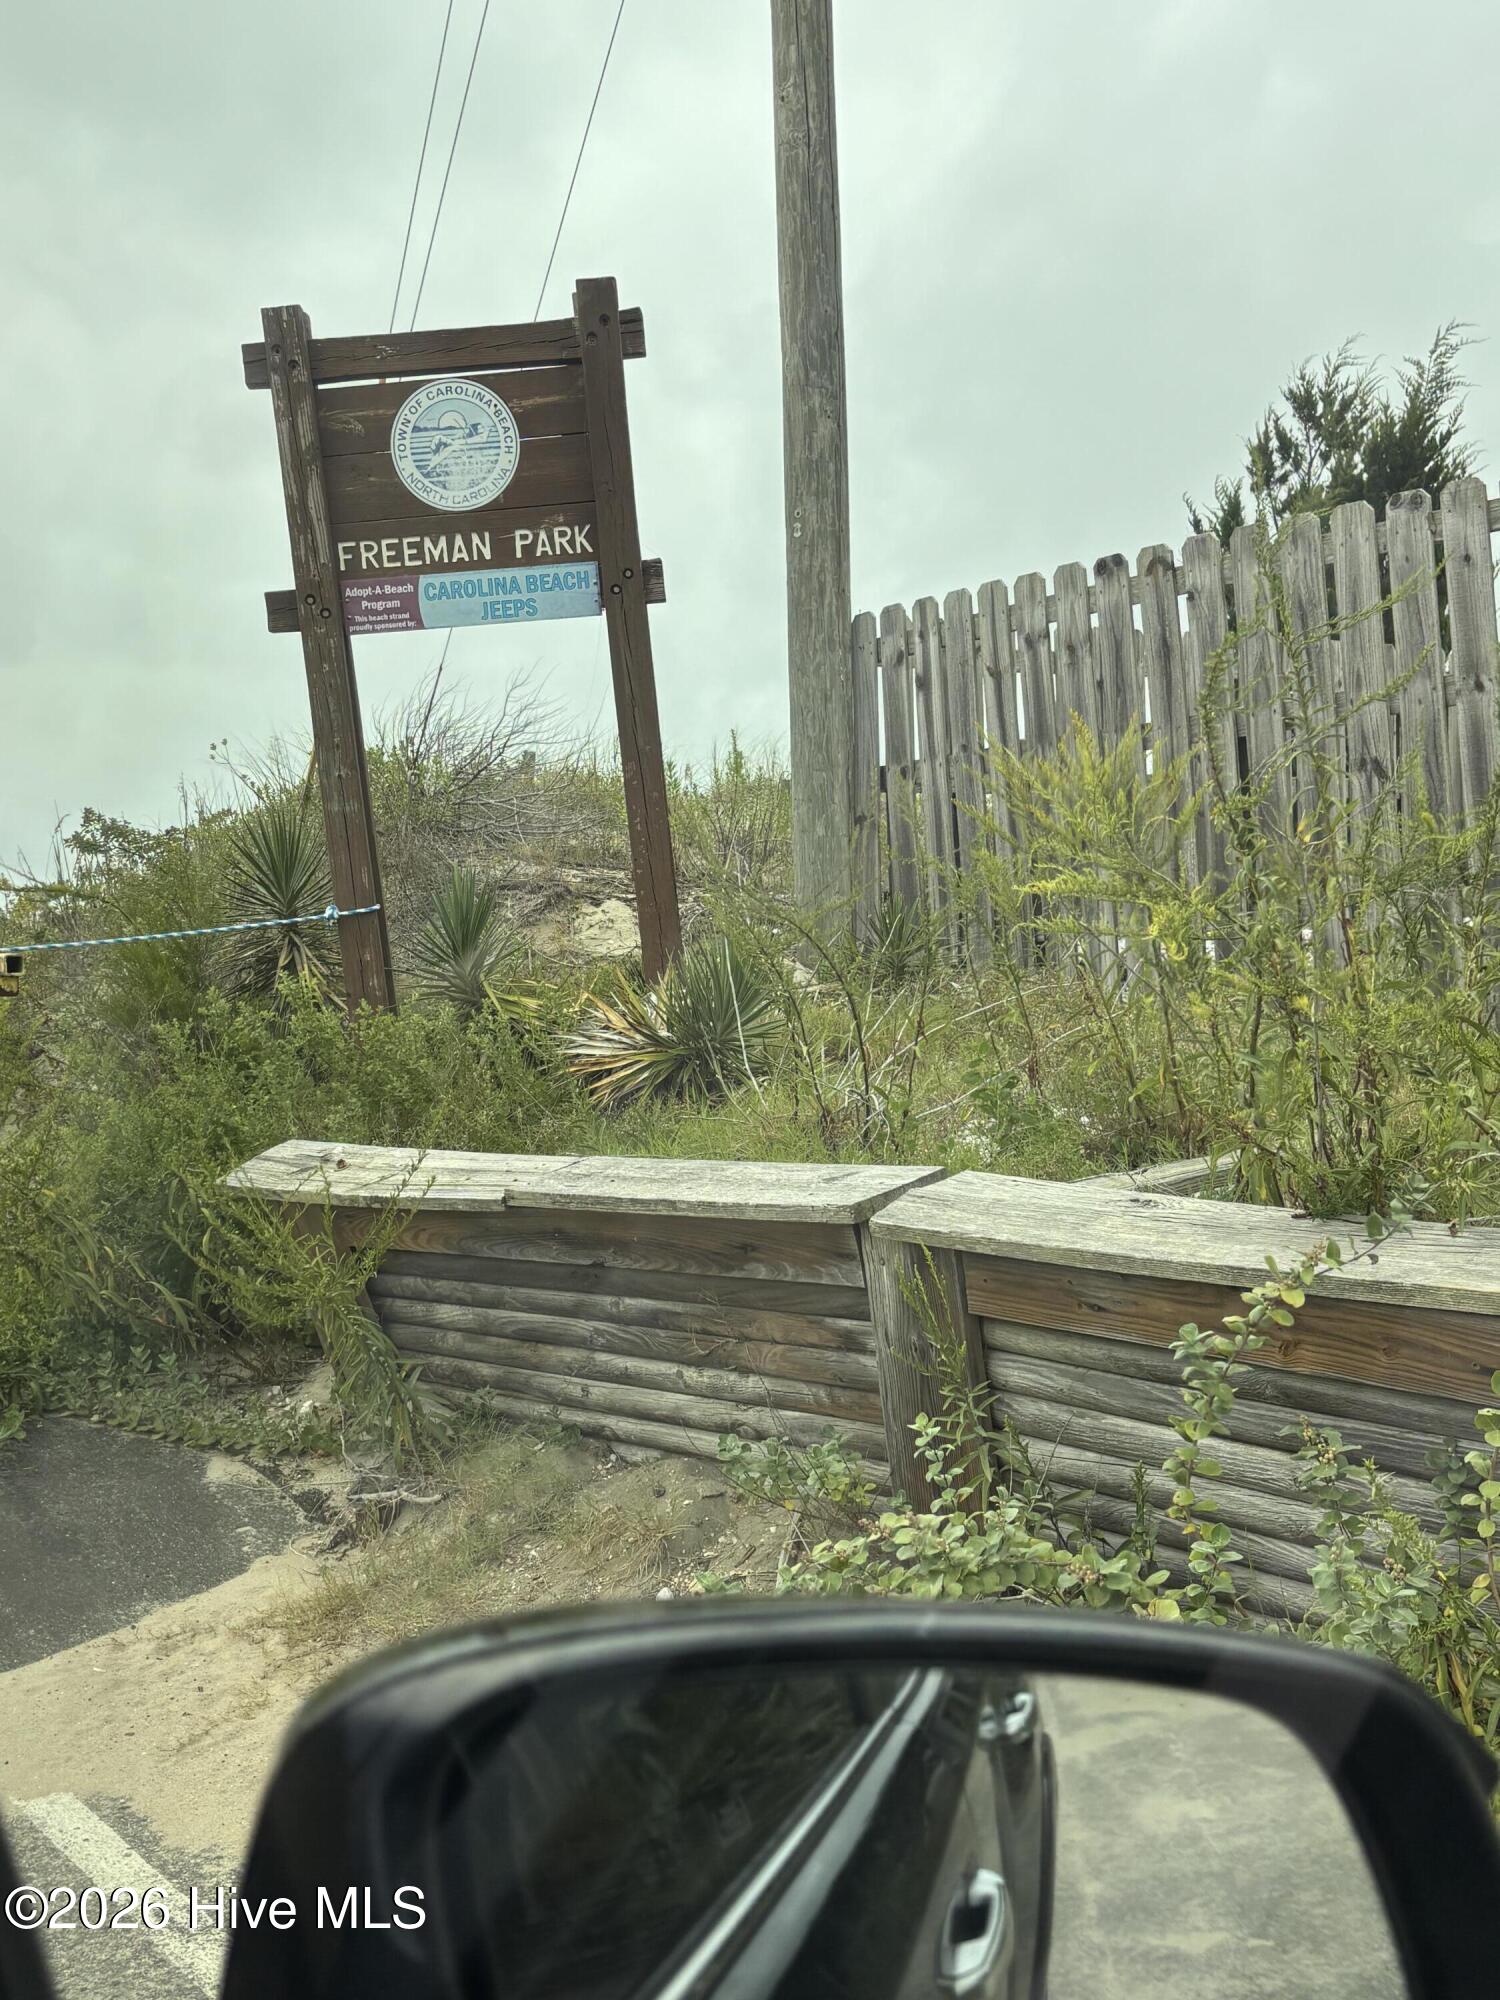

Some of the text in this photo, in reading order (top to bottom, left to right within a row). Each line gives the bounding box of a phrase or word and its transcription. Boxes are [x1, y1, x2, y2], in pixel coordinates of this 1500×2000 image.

[397, 385, 513, 461] TOWN OF CAROLINA BEACH
[406, 467, 511, 505] NORTH CAROLINA
[337, 524, 593, 571] FREEMAN PARK
[345, 583, 413, 597] Adopt-A-Beach
[424, 571, 590, 601] CAROLINA BEACH
[362, 600, 400, 610] Program
[481, 598, 537, 621] JEEPS
[349, 624, 373, 632] proudly
[374, 621, 406, 630] sponsored
